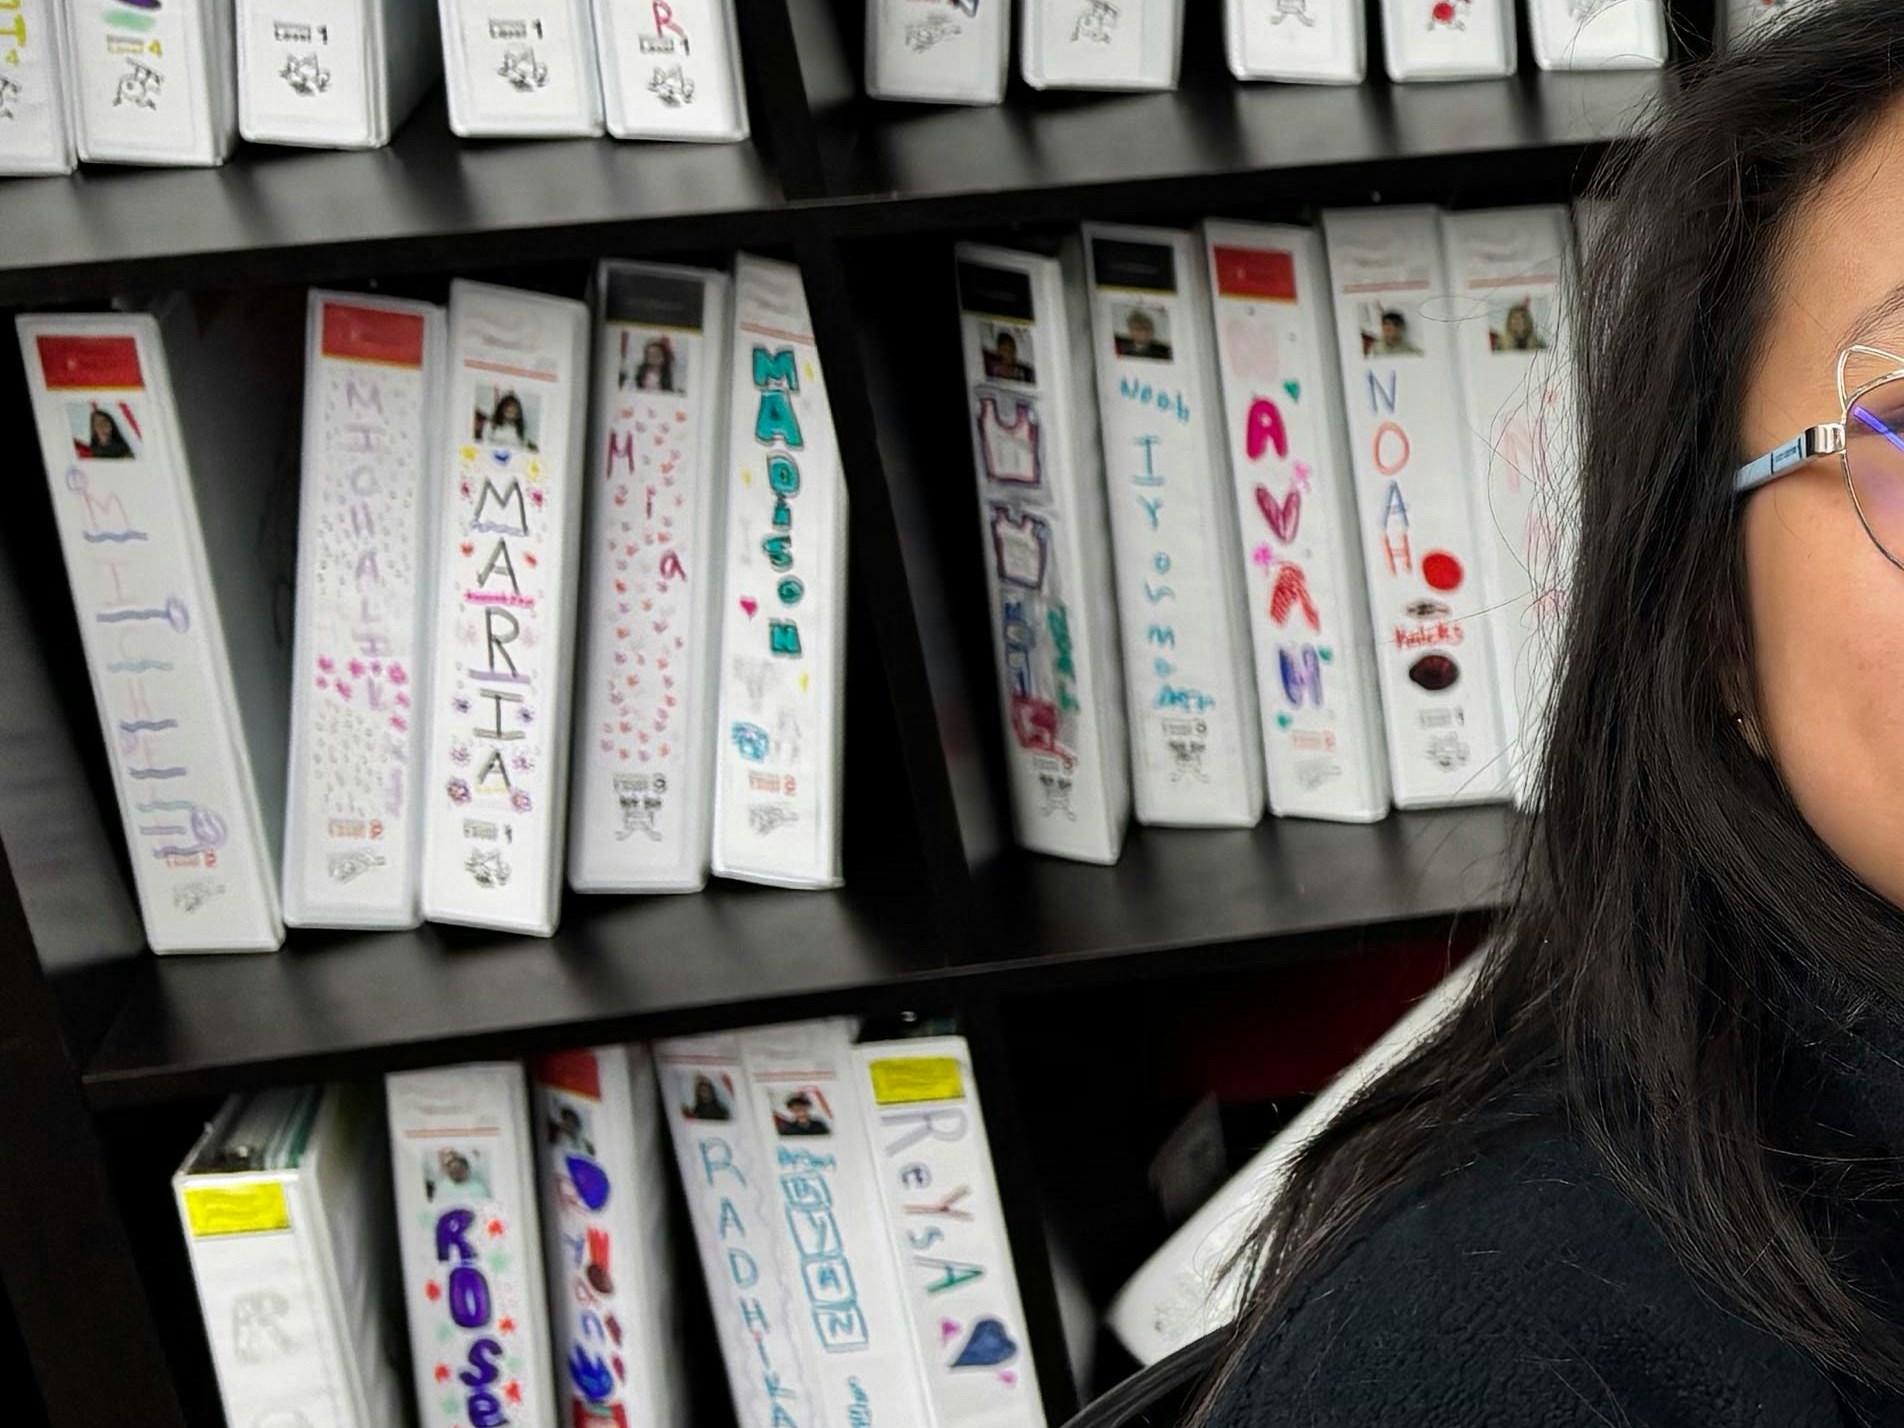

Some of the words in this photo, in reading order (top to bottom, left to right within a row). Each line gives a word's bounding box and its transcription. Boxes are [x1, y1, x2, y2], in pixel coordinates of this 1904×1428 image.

[606, 430, 687, 582] Mia
[749, 344, 806, 659] MADISON
[1366, 371, 1413, 578] NOAH
[473, 478, 530, 789] MARIA
